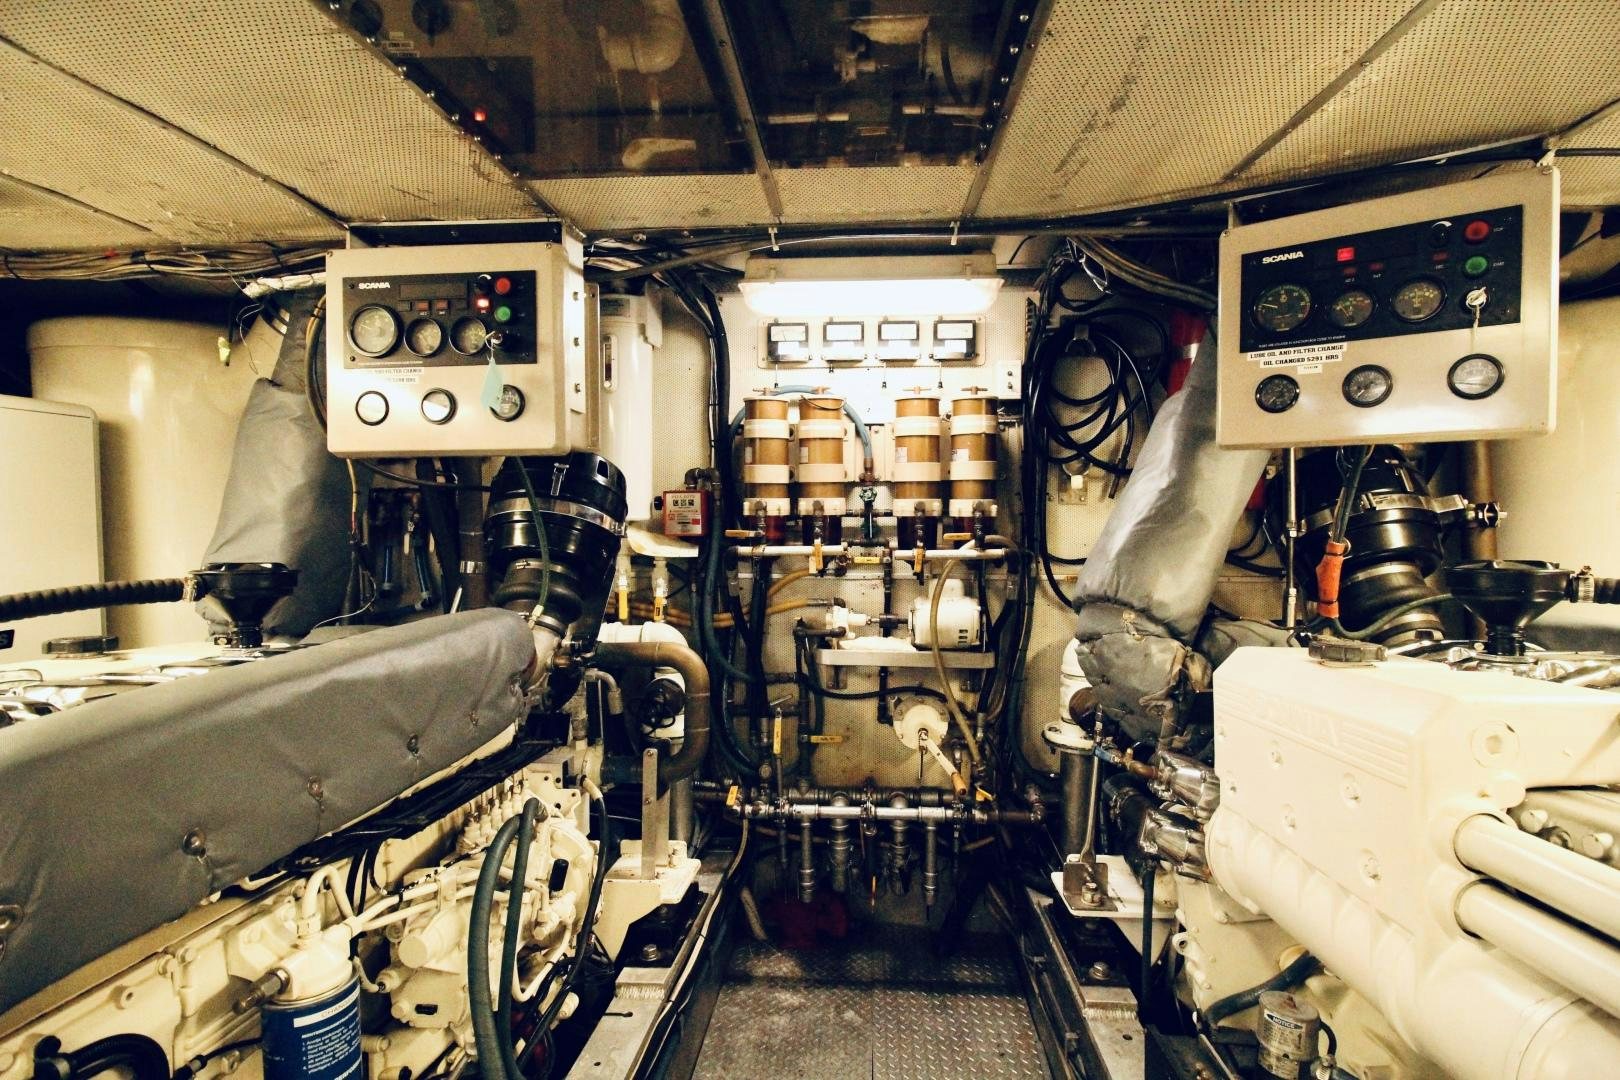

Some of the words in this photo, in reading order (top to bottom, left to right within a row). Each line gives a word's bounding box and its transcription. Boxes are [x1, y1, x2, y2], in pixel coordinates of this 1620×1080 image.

[1262, 250, 1304, 264] SCANIA
[358, 281, 391, 290] SCANIA
[1293, 347, 1316, 355] FILTER
[1317, 344, 1344, 352] CHANGE
[1273, 1016, 1295, 1028] NOTICE
